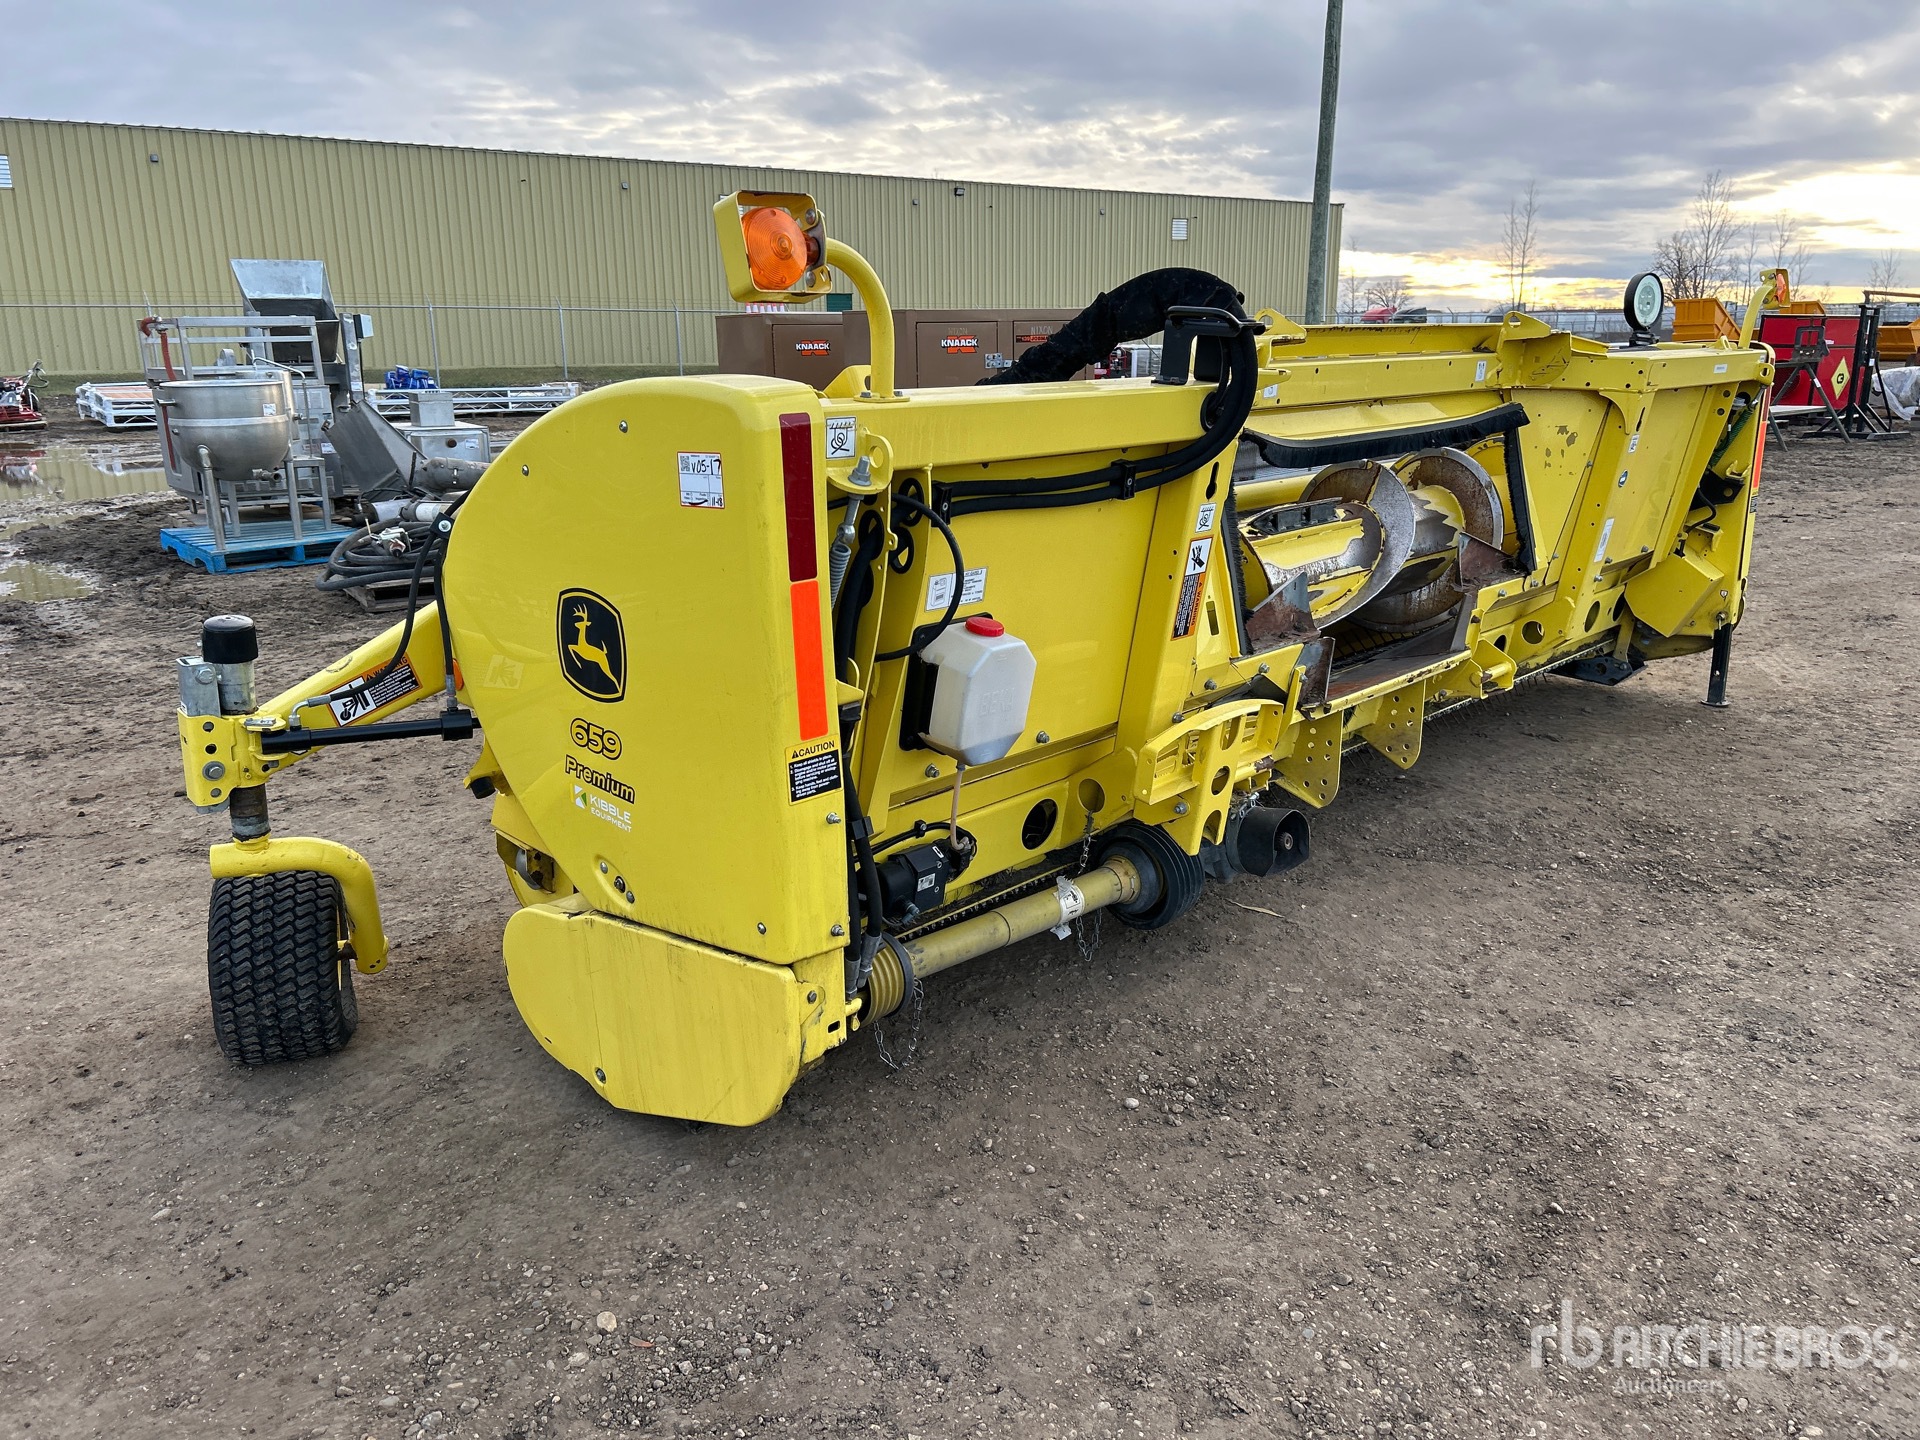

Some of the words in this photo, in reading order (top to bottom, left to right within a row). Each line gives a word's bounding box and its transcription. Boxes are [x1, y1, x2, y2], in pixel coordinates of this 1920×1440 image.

[795, 342, 830, 351] KNAACK
[941, 338, 979, 347] KNAACK
[569, 717, 623, 761] 659
[798, 740, 835, 757] CAUTION
[565, 753, 636, 805] Premium
[589, 794, 632, 825] KIBBLE
[590, 807, 632, 833] EQUIPMENT
